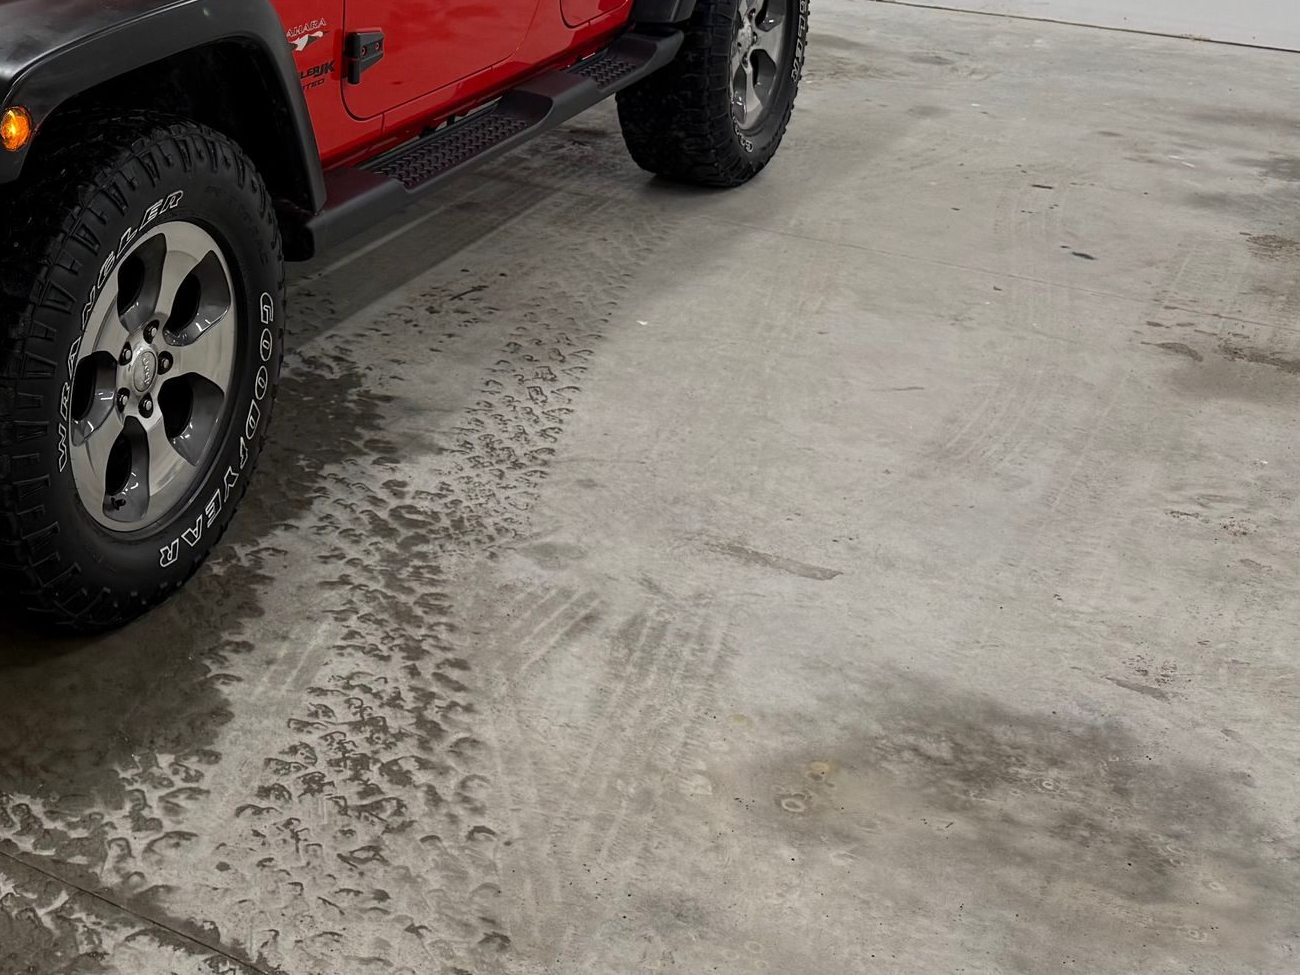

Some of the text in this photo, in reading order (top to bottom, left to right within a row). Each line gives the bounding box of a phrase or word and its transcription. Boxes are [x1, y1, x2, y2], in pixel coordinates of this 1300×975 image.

[286, 17, 327, 38] AHARA
[58, 190, 184, 473] WRANGLER
[159, 292, 274, 569] GOODYEAR
